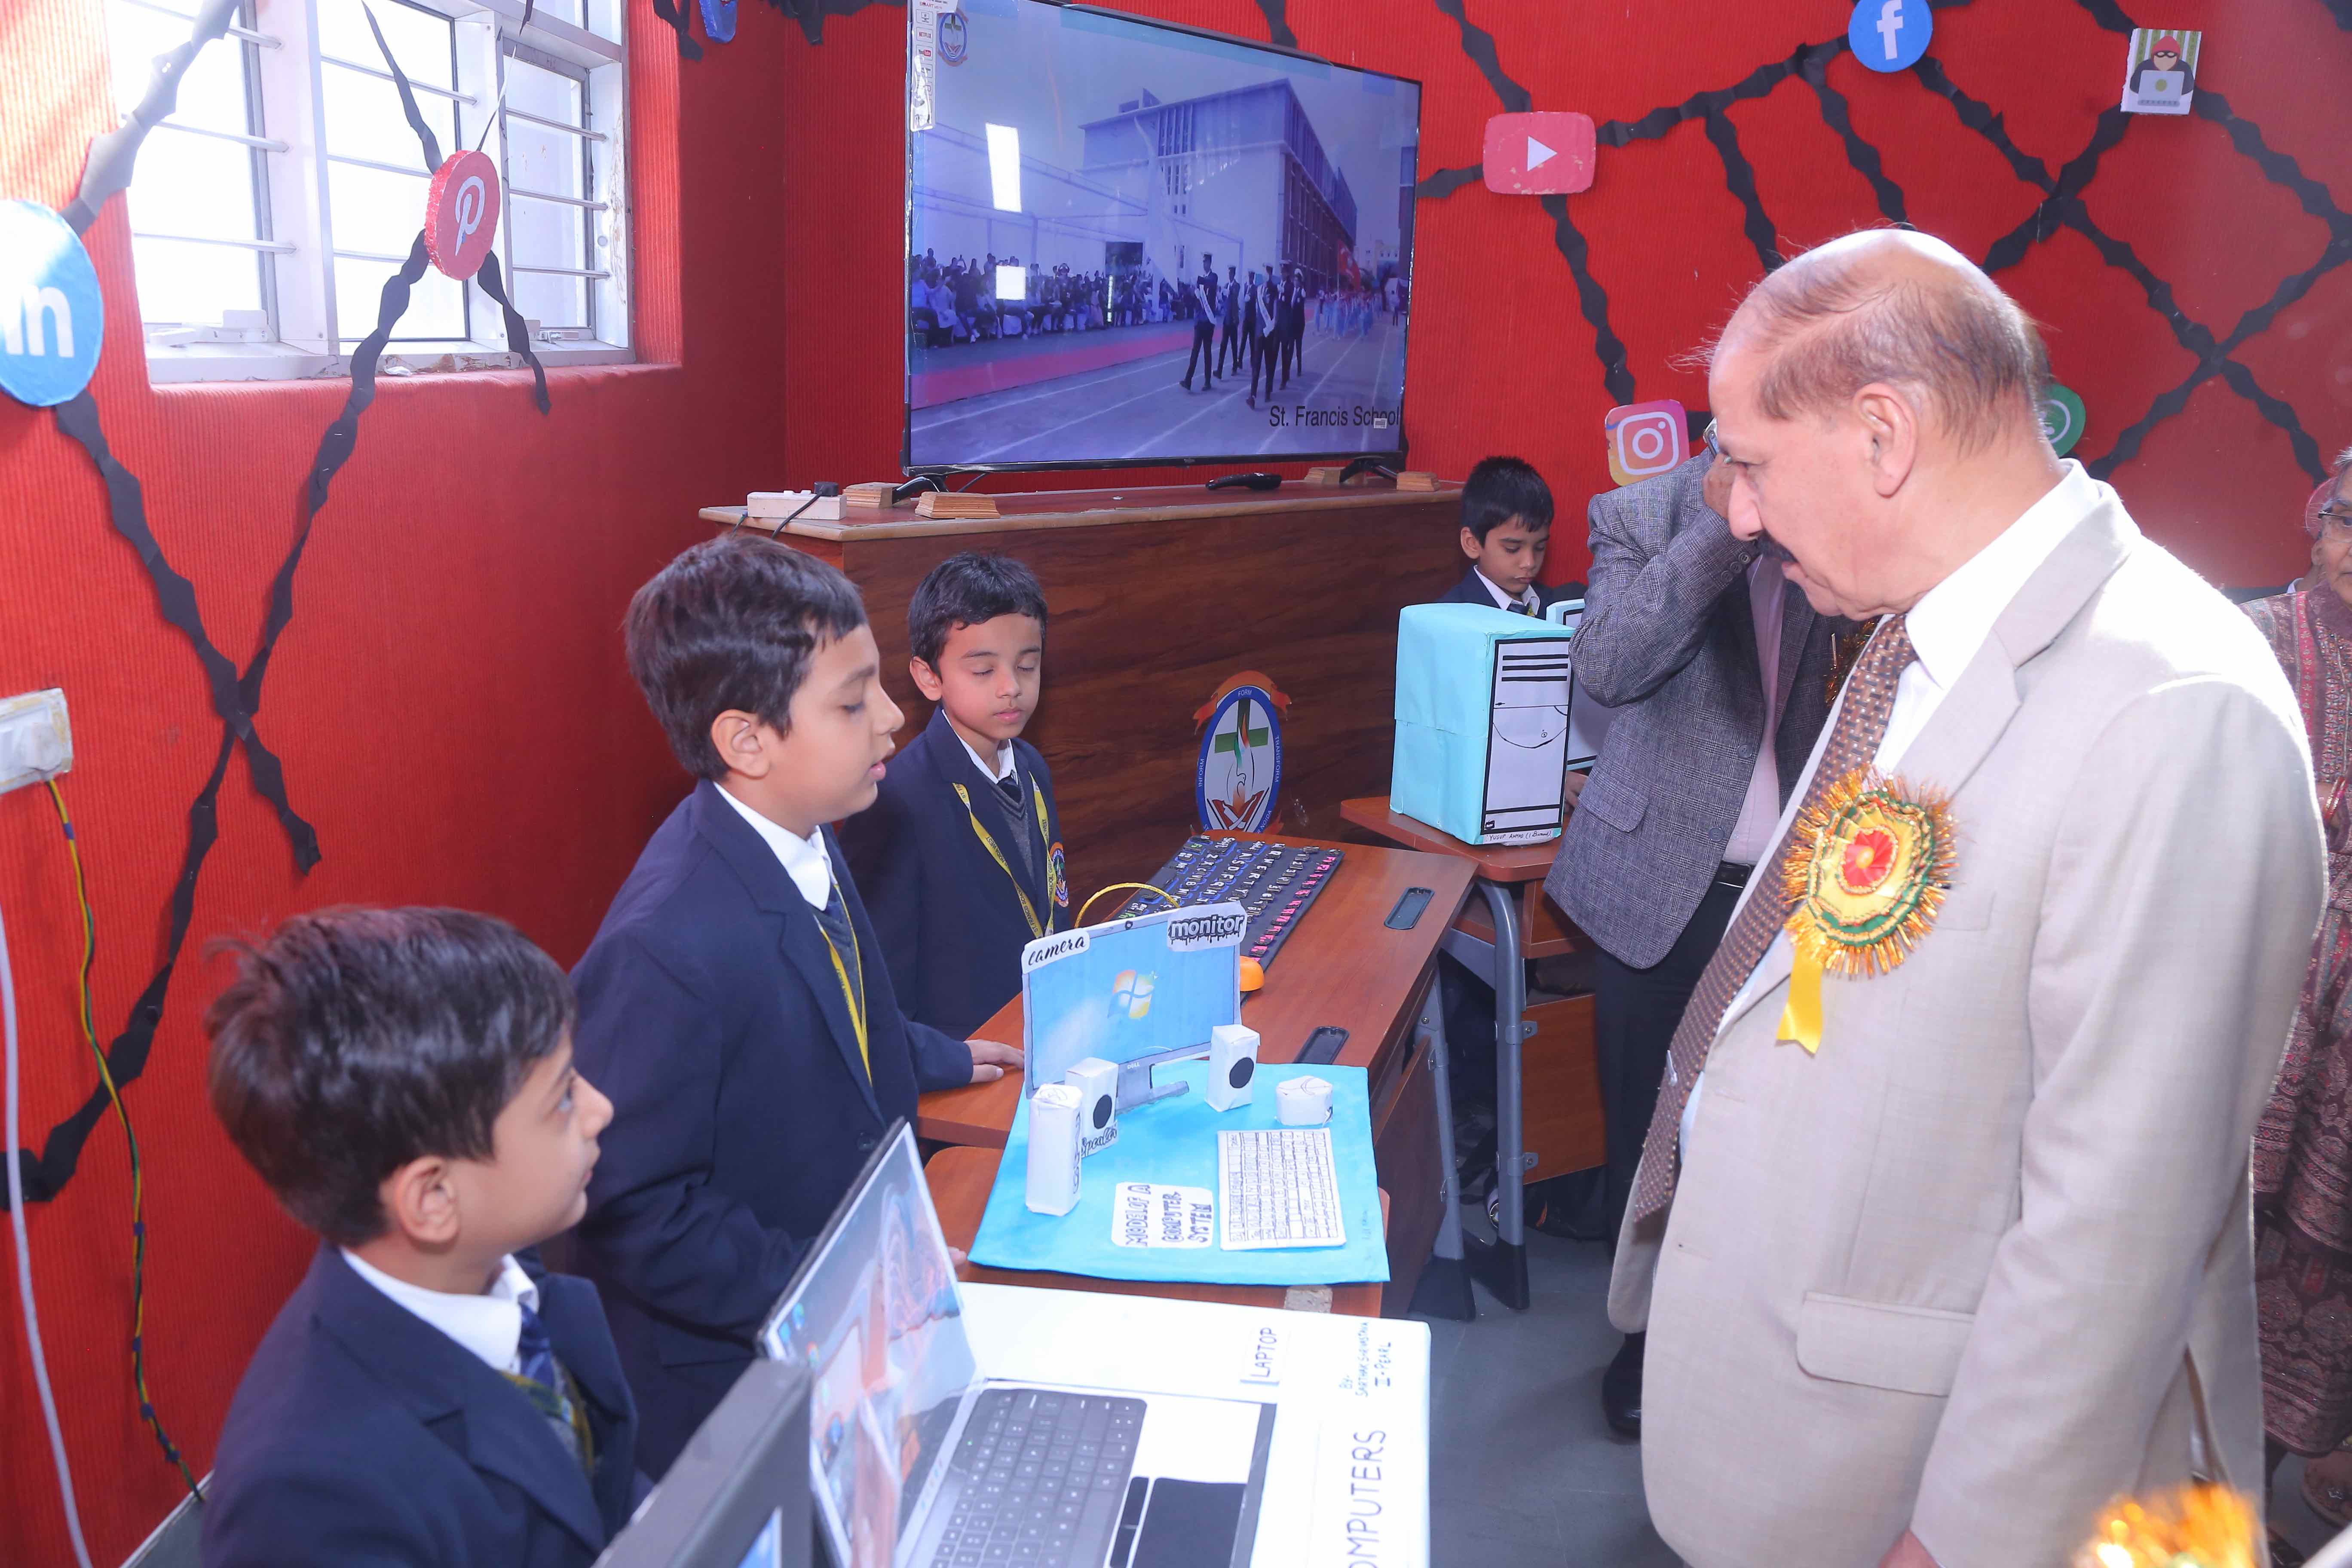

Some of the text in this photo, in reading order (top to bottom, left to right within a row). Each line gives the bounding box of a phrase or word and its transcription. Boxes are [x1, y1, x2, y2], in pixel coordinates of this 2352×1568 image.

[1269, 405, 1289, 427] St.
[1295, 405, 1348, 426] Francis
[1260, 810, 1272, 830] NOIDA
[1168, 913, 1246, 942] monitor
[1028, 935, 1086, 966] camera
[1127, 1185, 1151, 1194] A
[1161, 1191, 1184, 1243] COMPUTER
[1187, 1203, 1212, 1243] SYSTEM
[1250, 1327, 1277, 1378] LAPTOP
